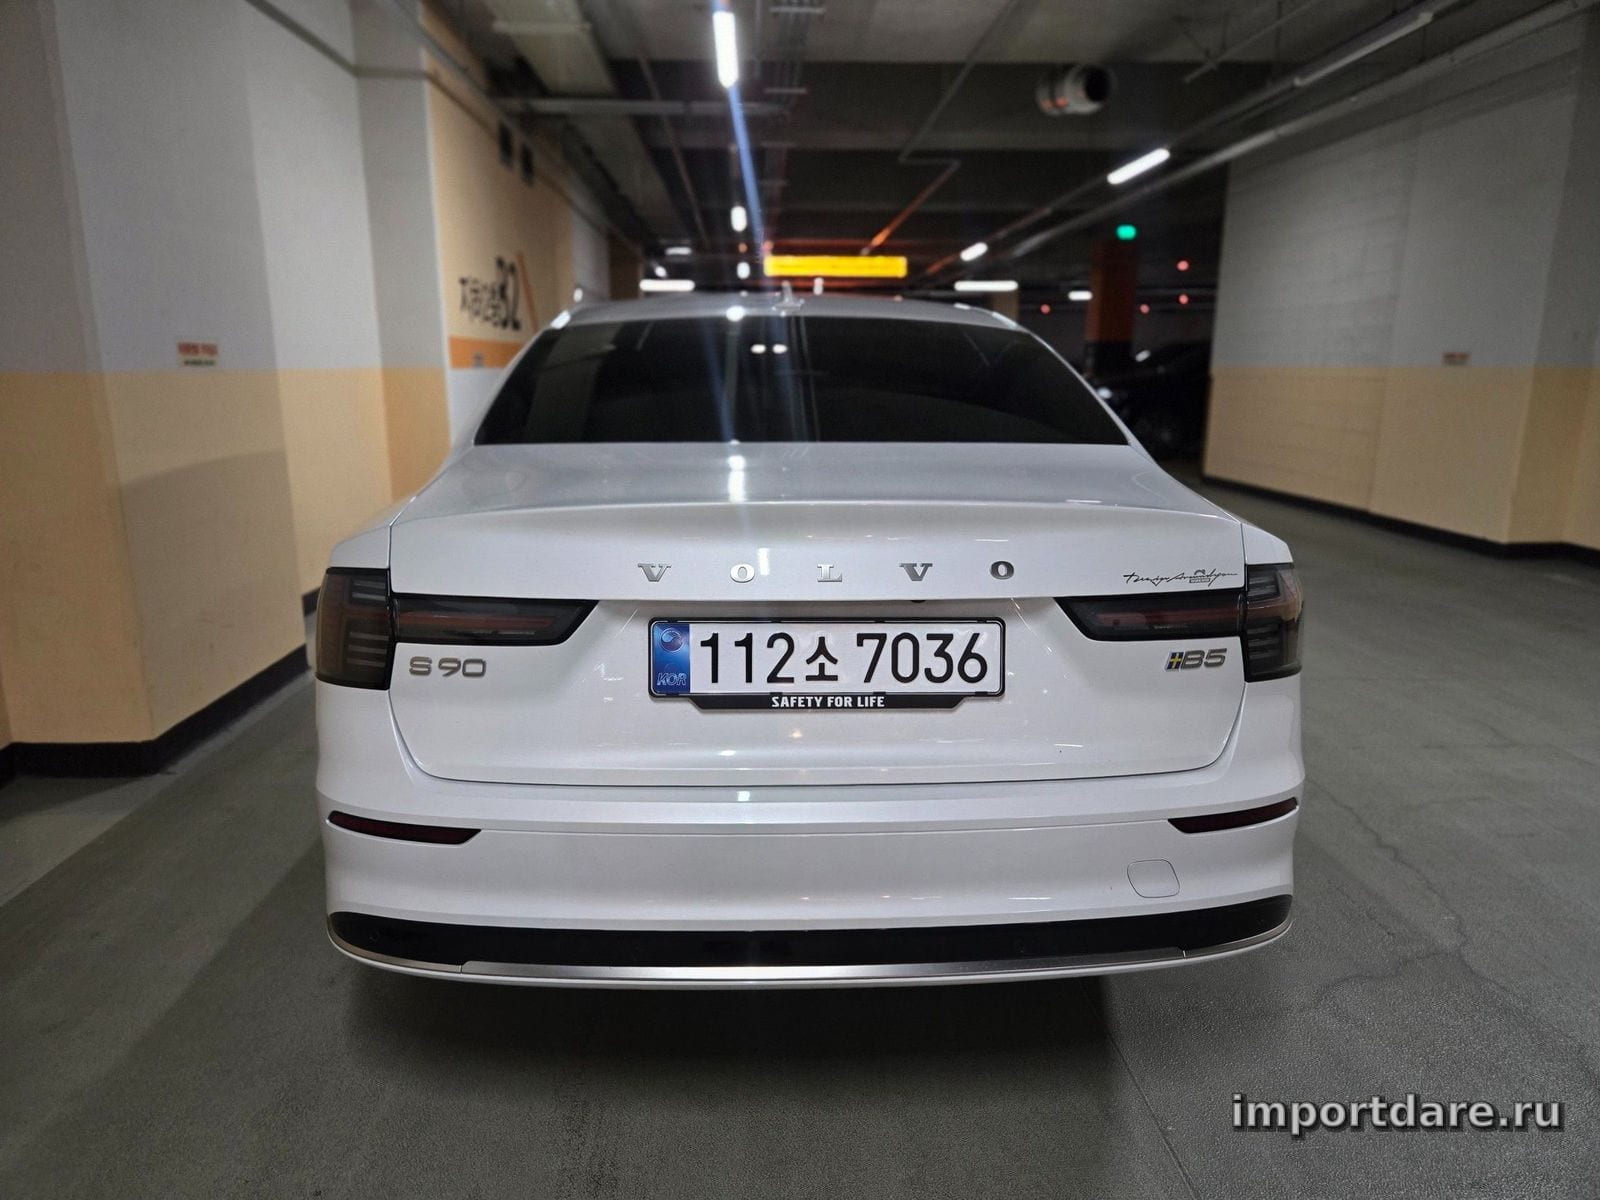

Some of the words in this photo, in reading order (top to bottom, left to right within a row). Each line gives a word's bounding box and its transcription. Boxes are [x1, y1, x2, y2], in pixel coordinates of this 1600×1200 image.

[637, 560, 1015, 583] VOLVO
[700, 632, 839, 684] 112소
[856, 632, 988, 684] 7036
[1180, 648, 1228, 670] B5
[656, 672, 687, 686] KOR
[771, 696, 823, 708] SAFETY
[827, 696, 852, 708] FOR
[857, 696, 885, 708] LIFE
